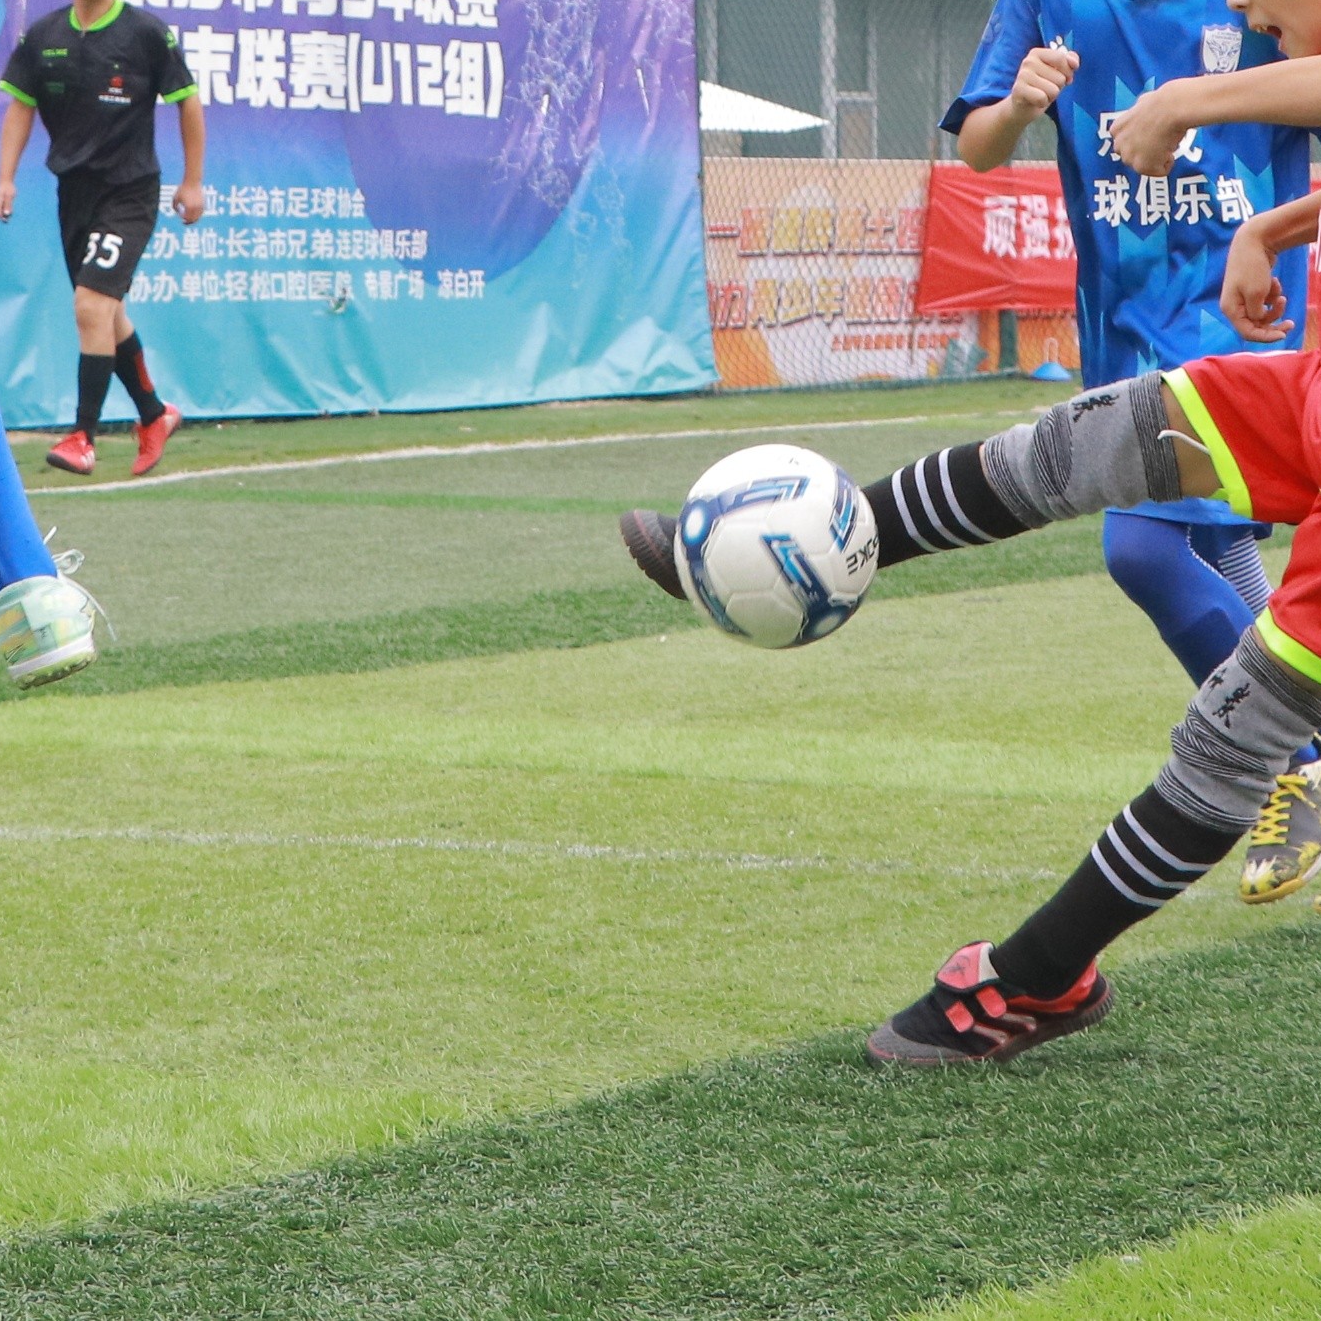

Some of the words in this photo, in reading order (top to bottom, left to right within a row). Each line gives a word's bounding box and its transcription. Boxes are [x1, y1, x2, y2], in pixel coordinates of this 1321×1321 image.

[168, 25, 503, 119] 末联赛(U12组)
[141, 227, 428, 261] 办单位:长治市兄弟连足球俱乐部
